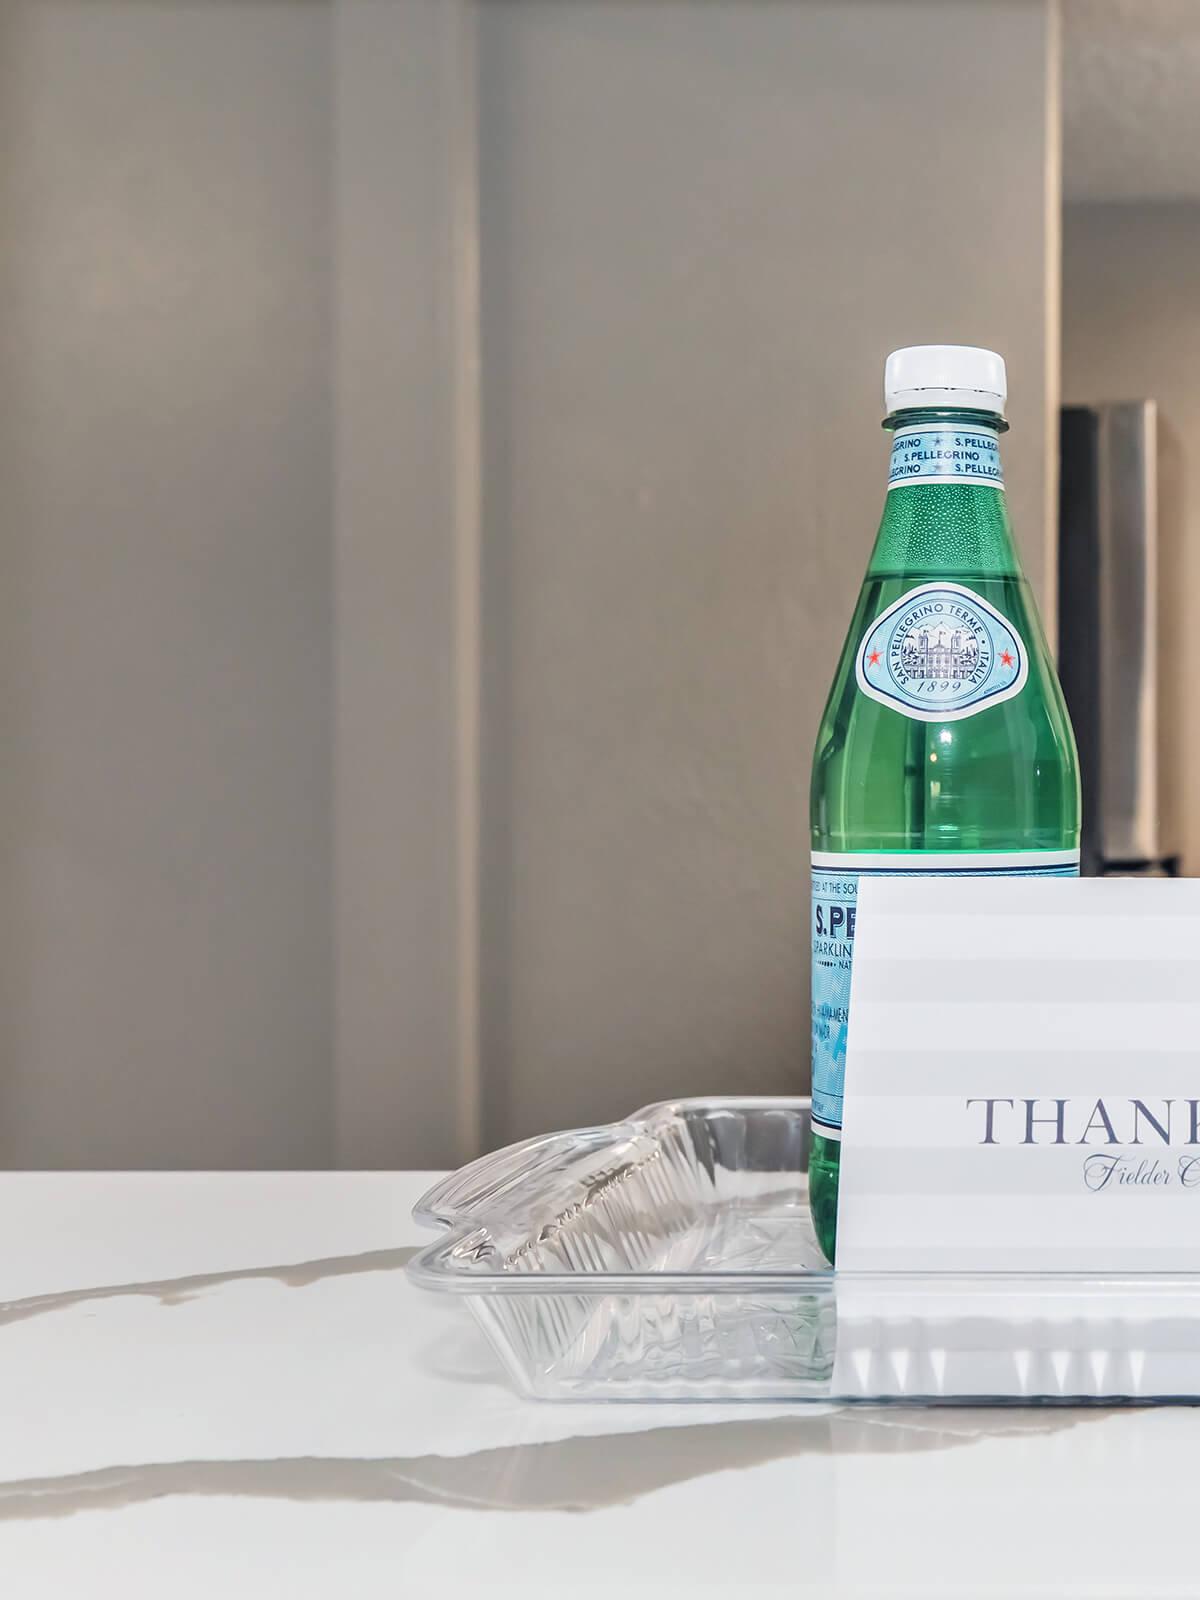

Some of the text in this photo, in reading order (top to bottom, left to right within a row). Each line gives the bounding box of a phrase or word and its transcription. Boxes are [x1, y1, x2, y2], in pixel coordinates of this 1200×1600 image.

[891, 603, 990, 685] SAN PELLEGRINO TERME ITALIA
[915, 680, 962, 693] 1899
[1083, 1153, 1171, 1193] Fielder
